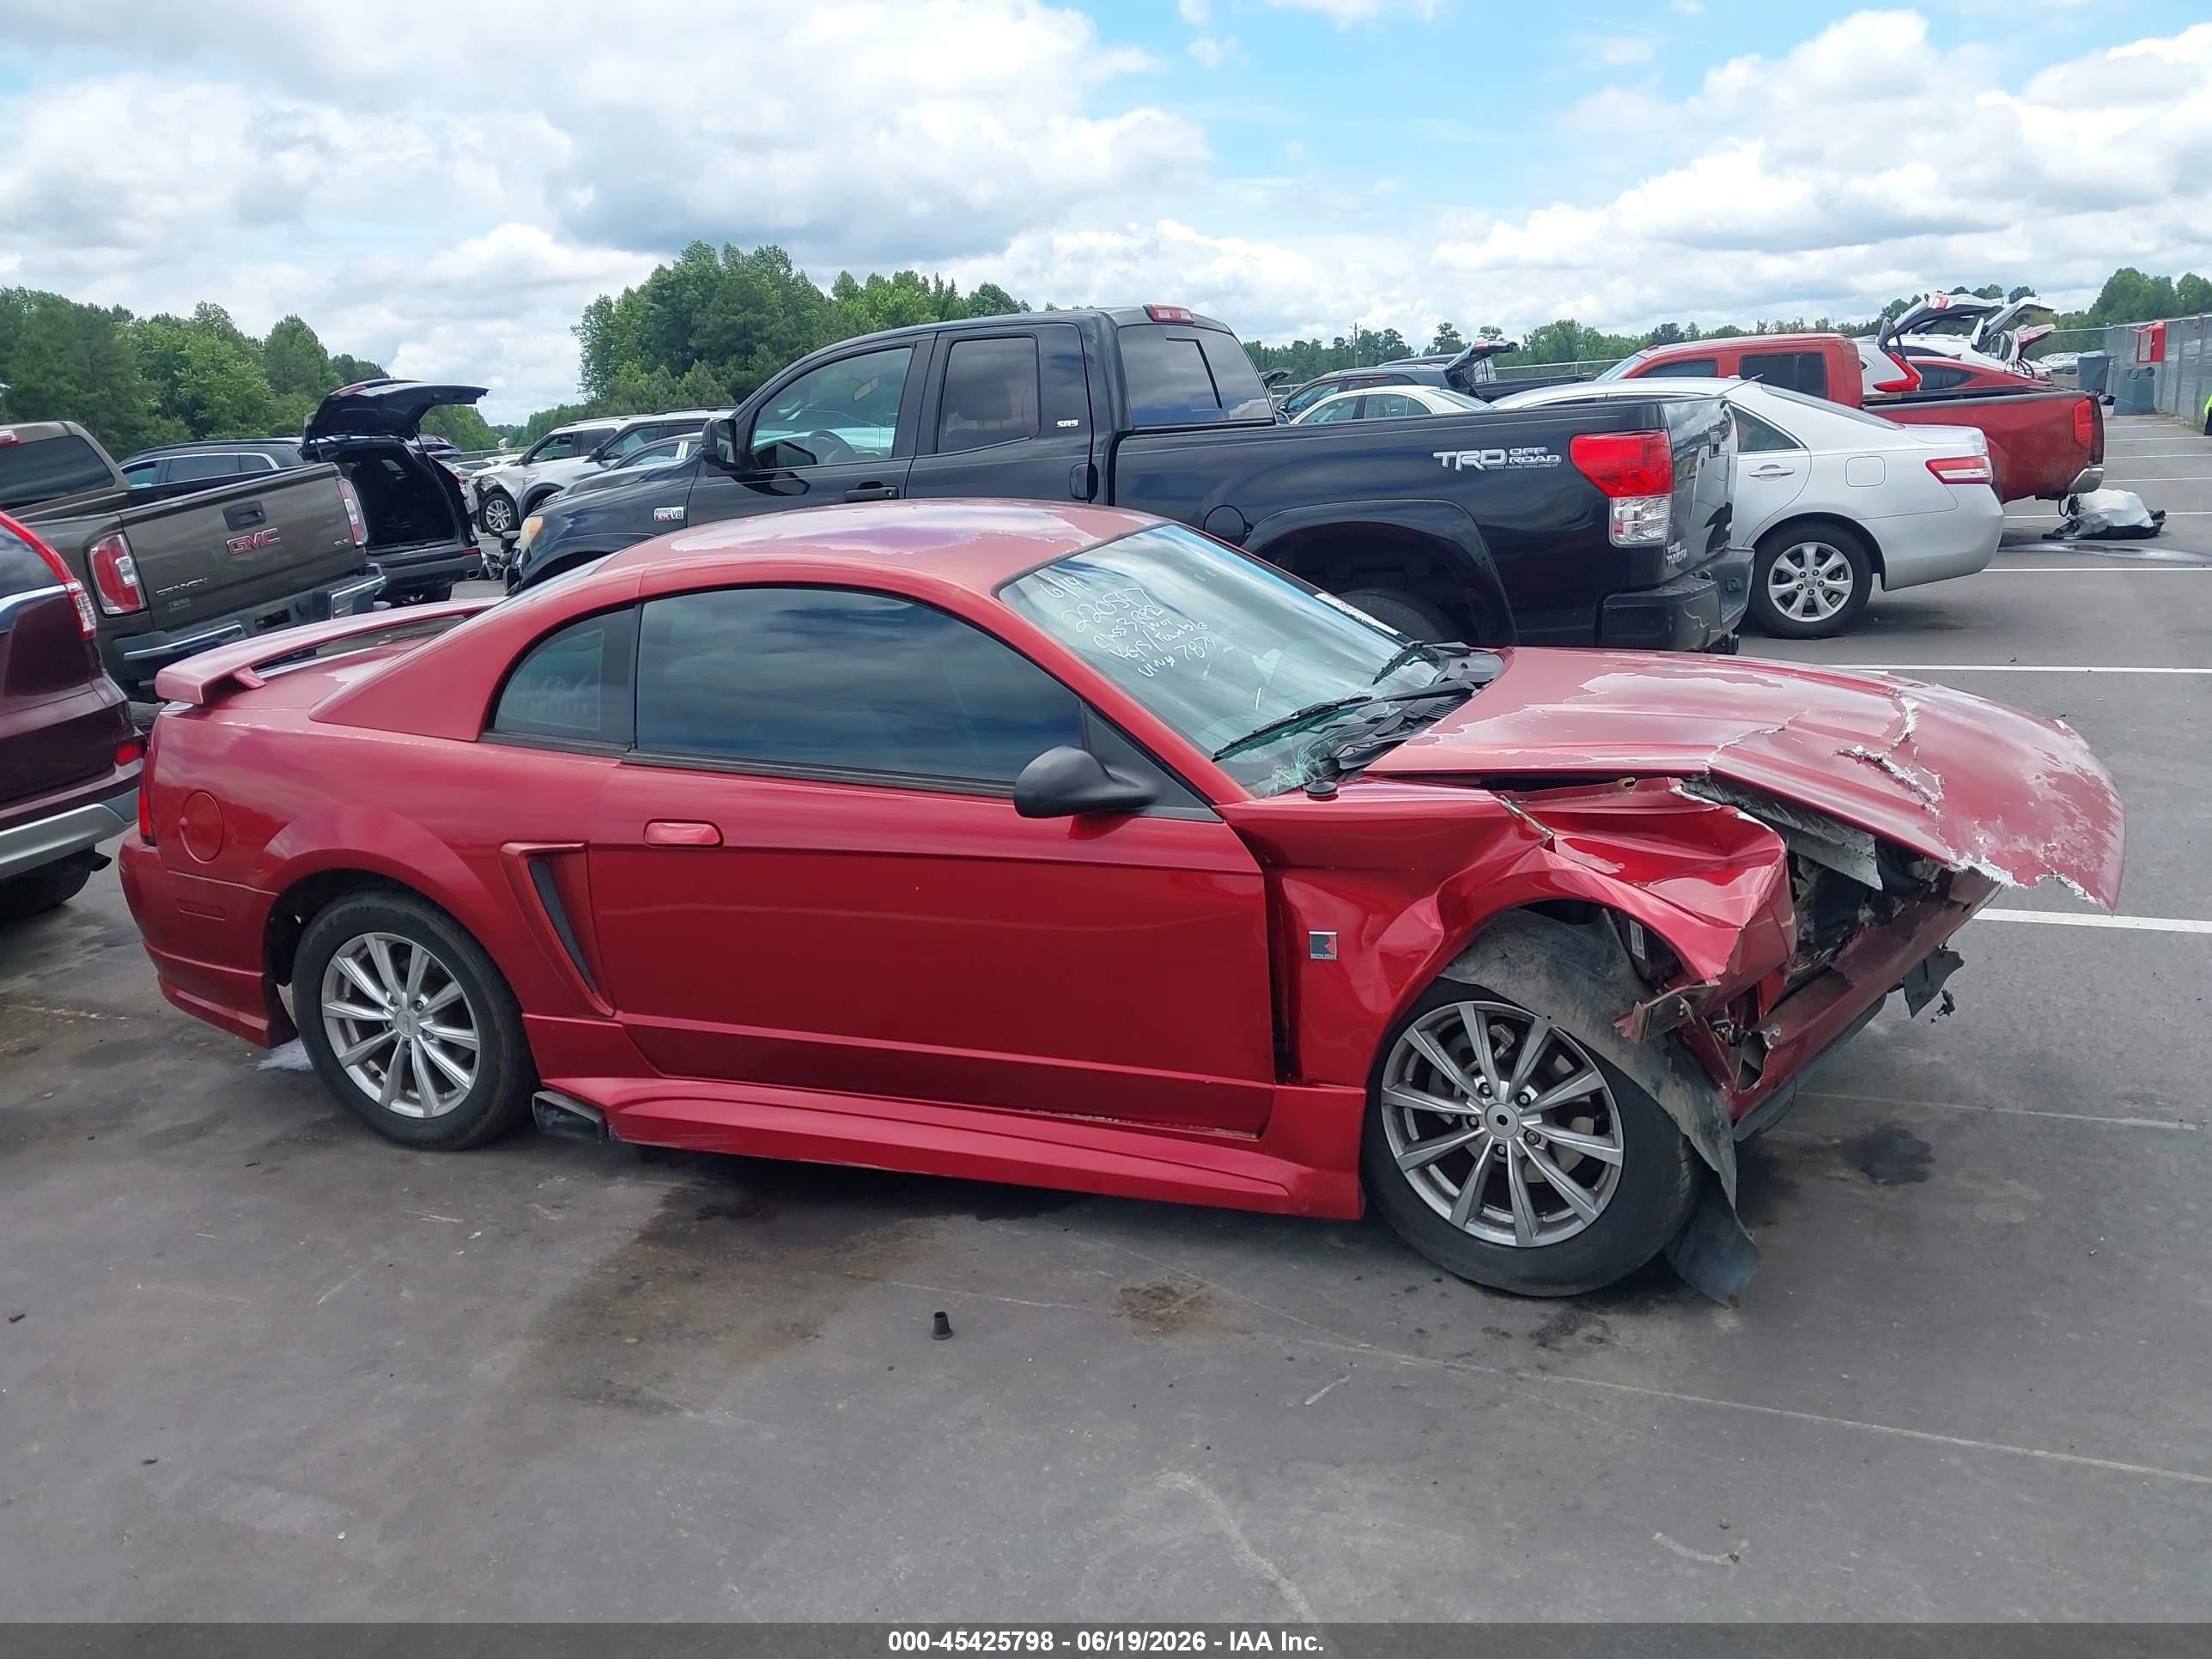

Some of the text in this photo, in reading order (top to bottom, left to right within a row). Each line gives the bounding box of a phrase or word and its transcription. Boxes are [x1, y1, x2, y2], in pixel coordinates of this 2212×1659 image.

[1433, 448, 1507, 471] TRD
[1509, 447, 1549, 456] OFF
[1509, 454, 1562, 465] ROAD
[226, 527, 281, 556] GMC
